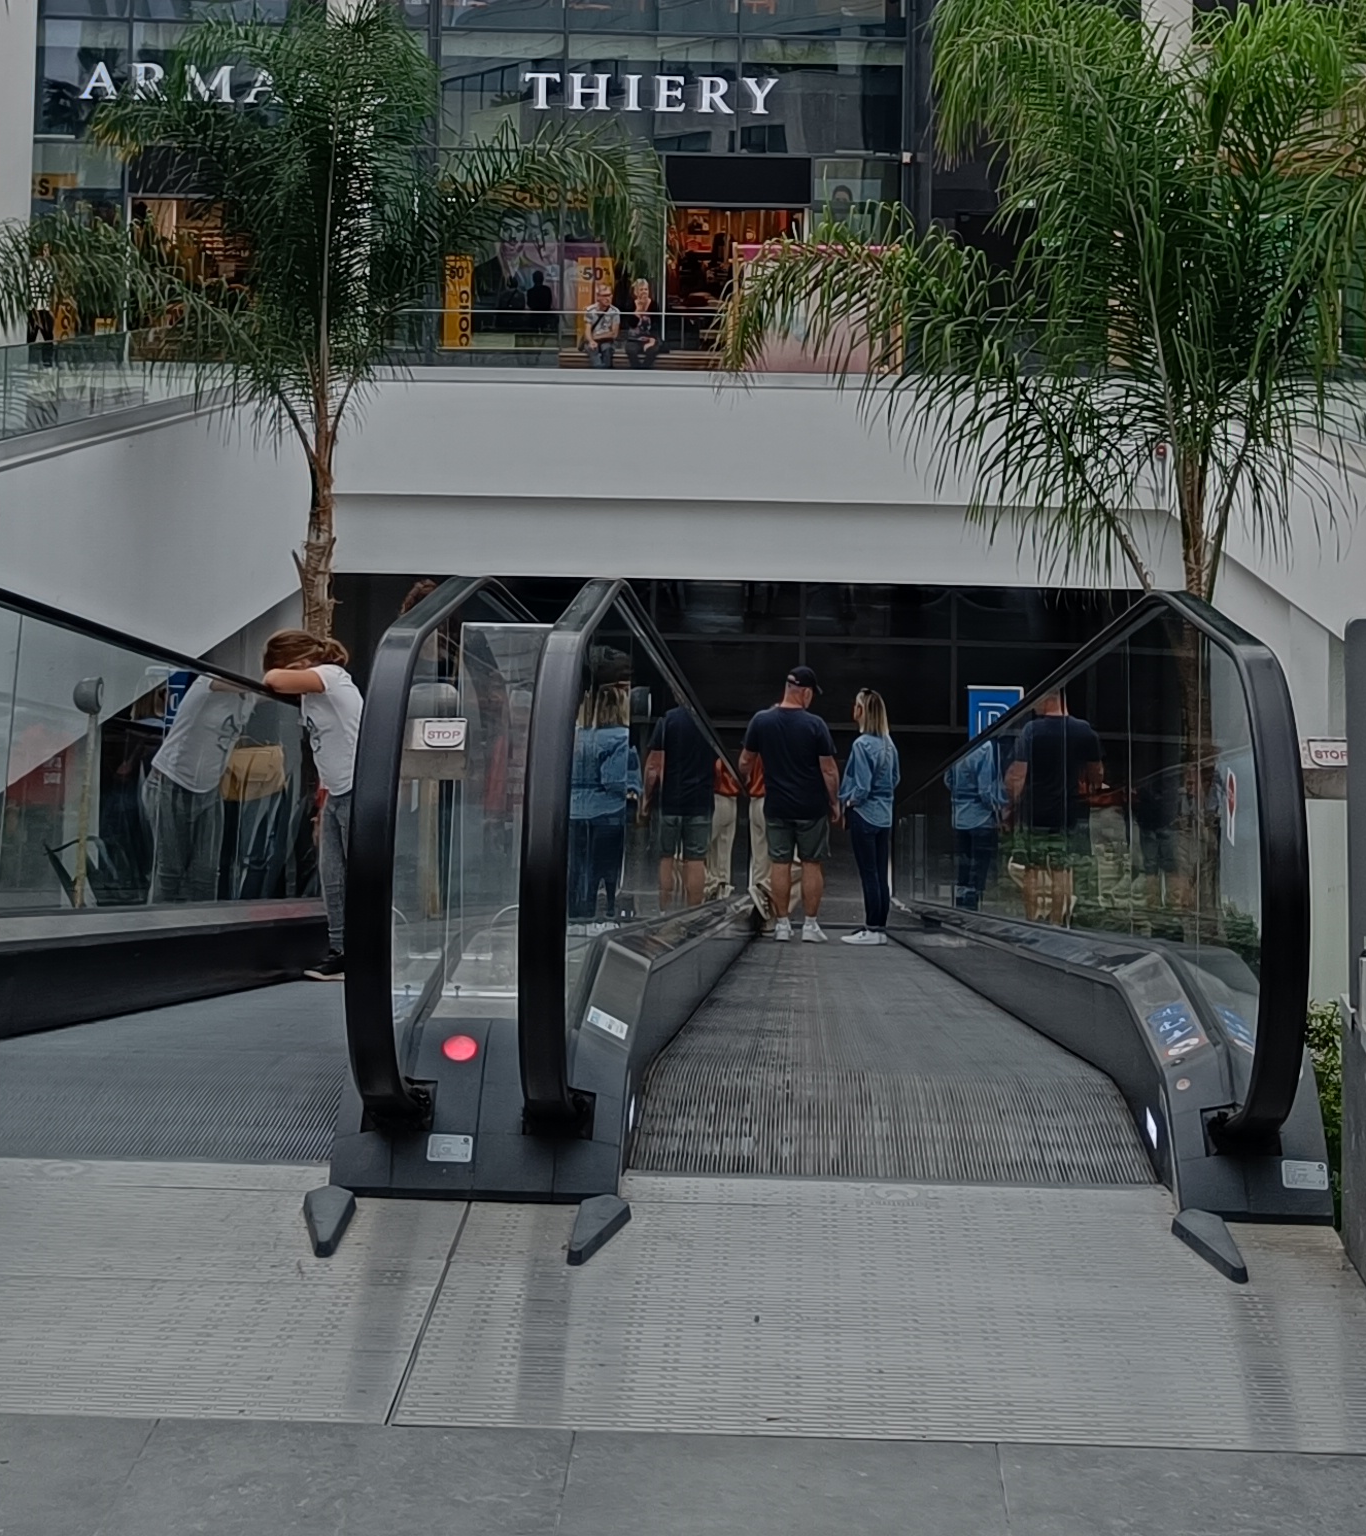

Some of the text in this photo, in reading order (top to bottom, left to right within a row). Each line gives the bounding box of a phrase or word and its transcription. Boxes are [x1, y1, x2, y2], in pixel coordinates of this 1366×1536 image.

[78, 61, 780, 115] ARMA THIERY
[427, 730, 461, 740] STOP
